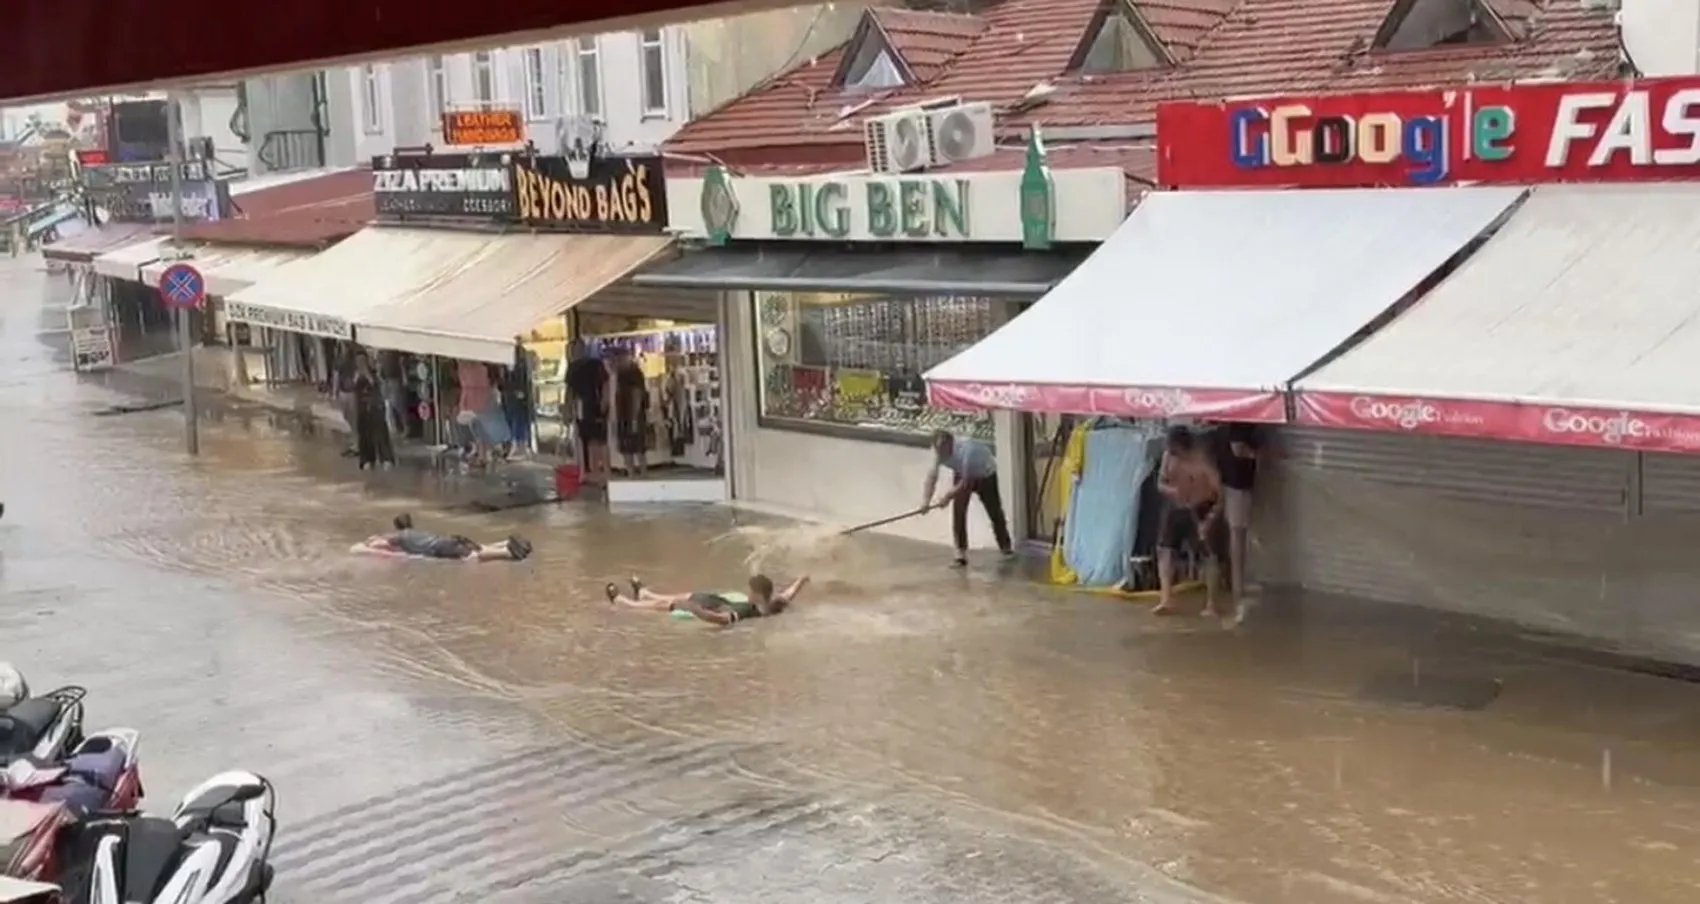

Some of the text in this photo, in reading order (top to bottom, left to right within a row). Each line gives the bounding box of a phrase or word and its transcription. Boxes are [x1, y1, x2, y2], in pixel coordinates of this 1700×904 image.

[1545, 88, 1700, 167] FAS
[372, 167, 511, 192] ZIZA PREMIUM
[516, 158, 652, 223] BEYOND BAG'S
[769, 179, 971, 237] BIG BEN
[1124, 388, 1191, 415] Google
[1351, 396, 1435, 428] Google
[1544, 407, 1644, 443] Google
